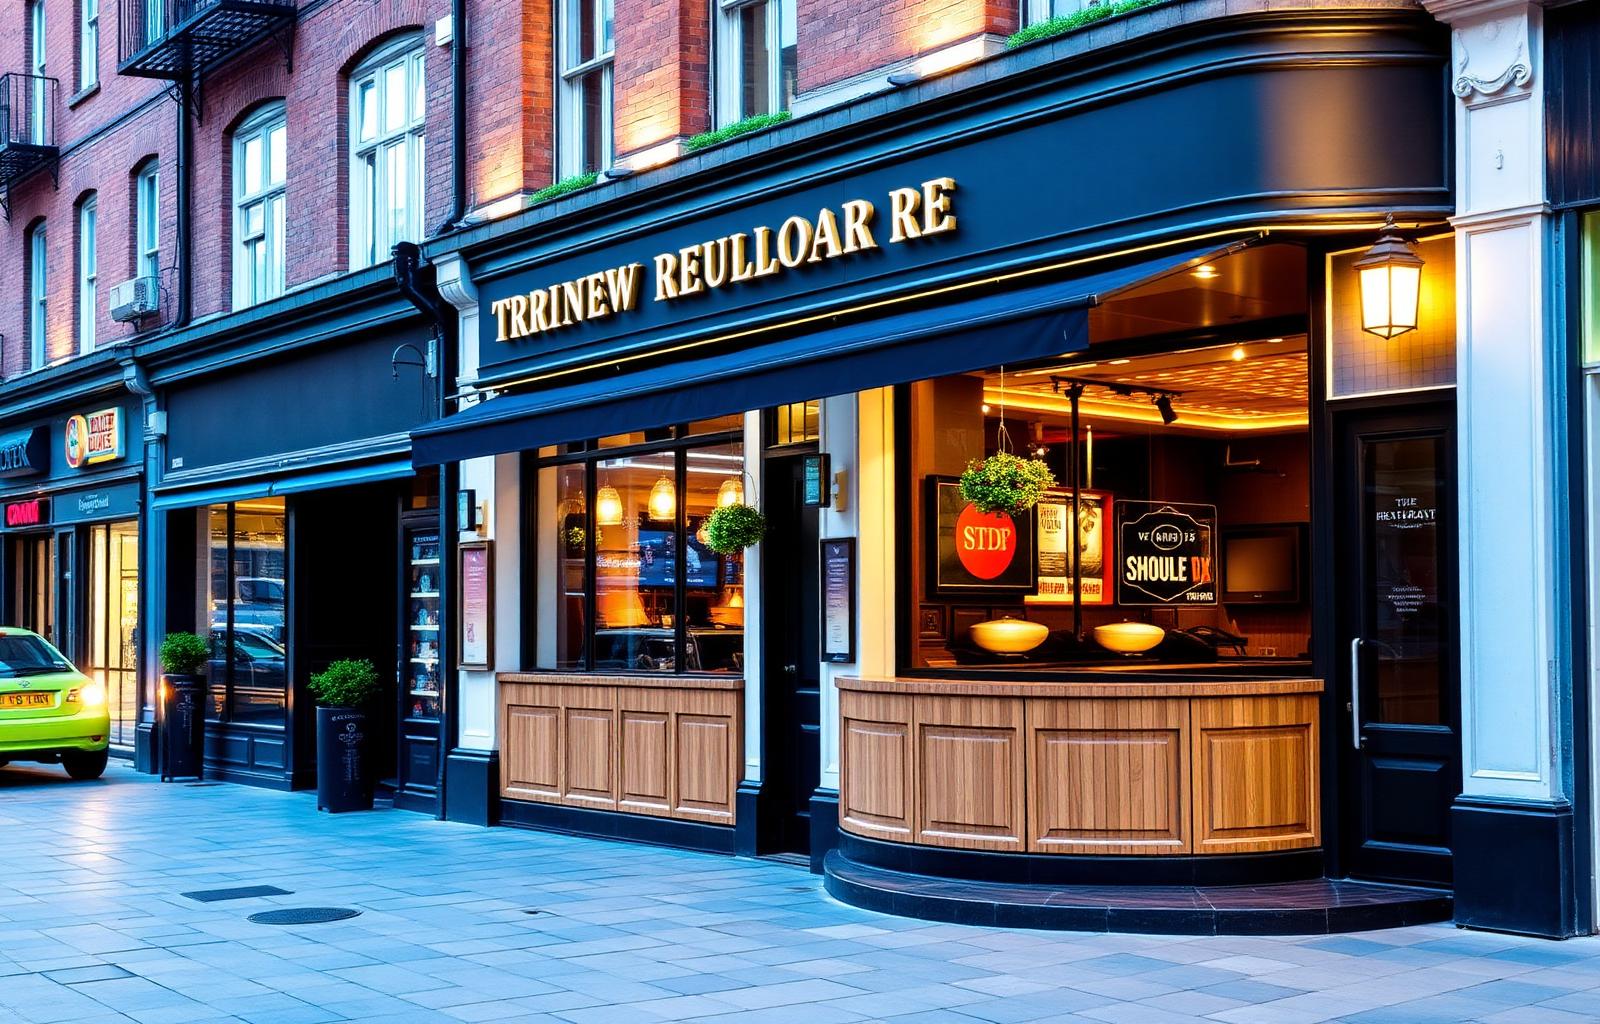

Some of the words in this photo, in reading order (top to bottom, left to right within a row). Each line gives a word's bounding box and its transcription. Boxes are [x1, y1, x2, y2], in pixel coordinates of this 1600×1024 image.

[491, 262, 645, 342] TRRINEW
[653, 198, 879, 302] REULLOAR
[888, 176, 958, 244] RE
[1126, 555, 1188, 582] SHOULE
